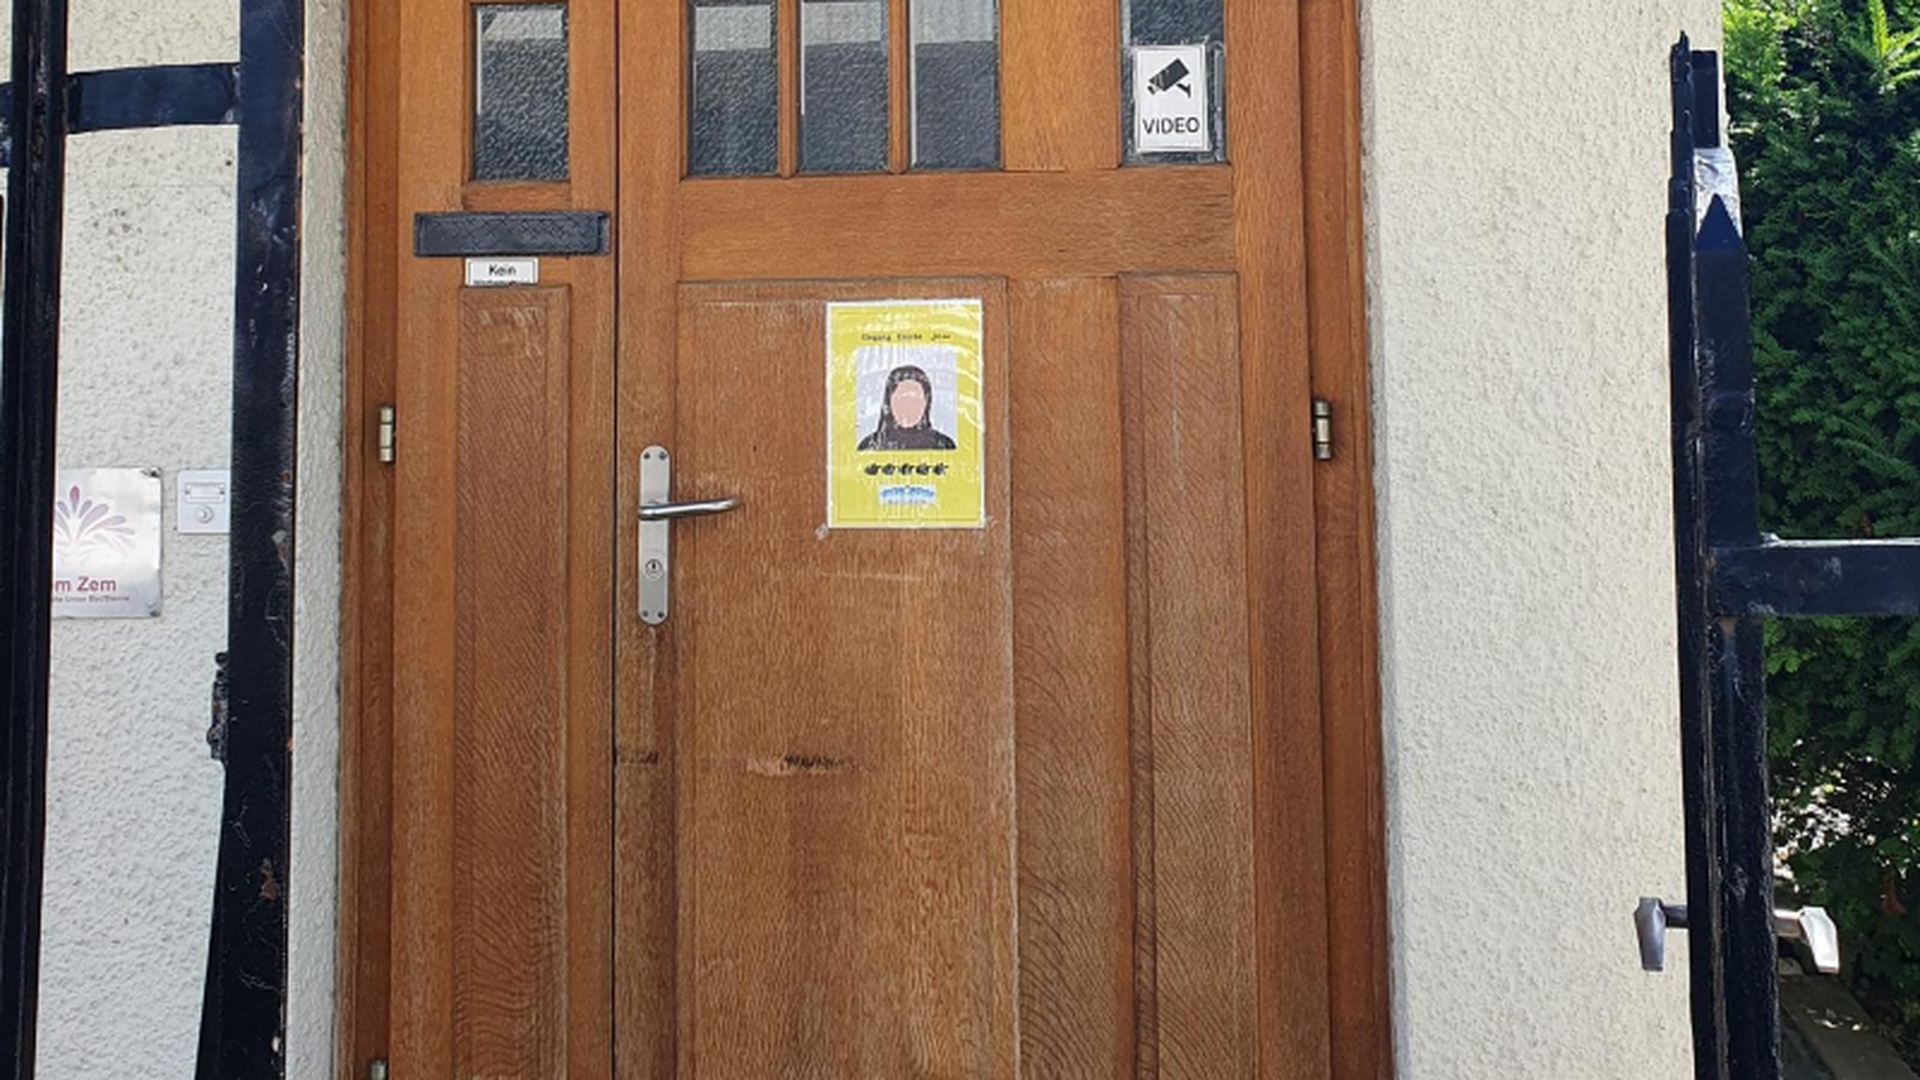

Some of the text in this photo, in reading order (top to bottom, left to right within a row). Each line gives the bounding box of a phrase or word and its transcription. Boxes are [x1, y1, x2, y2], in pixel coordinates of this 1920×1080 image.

[1142, 117, 1200, 134] VIDEO
[489, 264, 517, 276] Kein
[52, 576, 116, 592] m Zem
